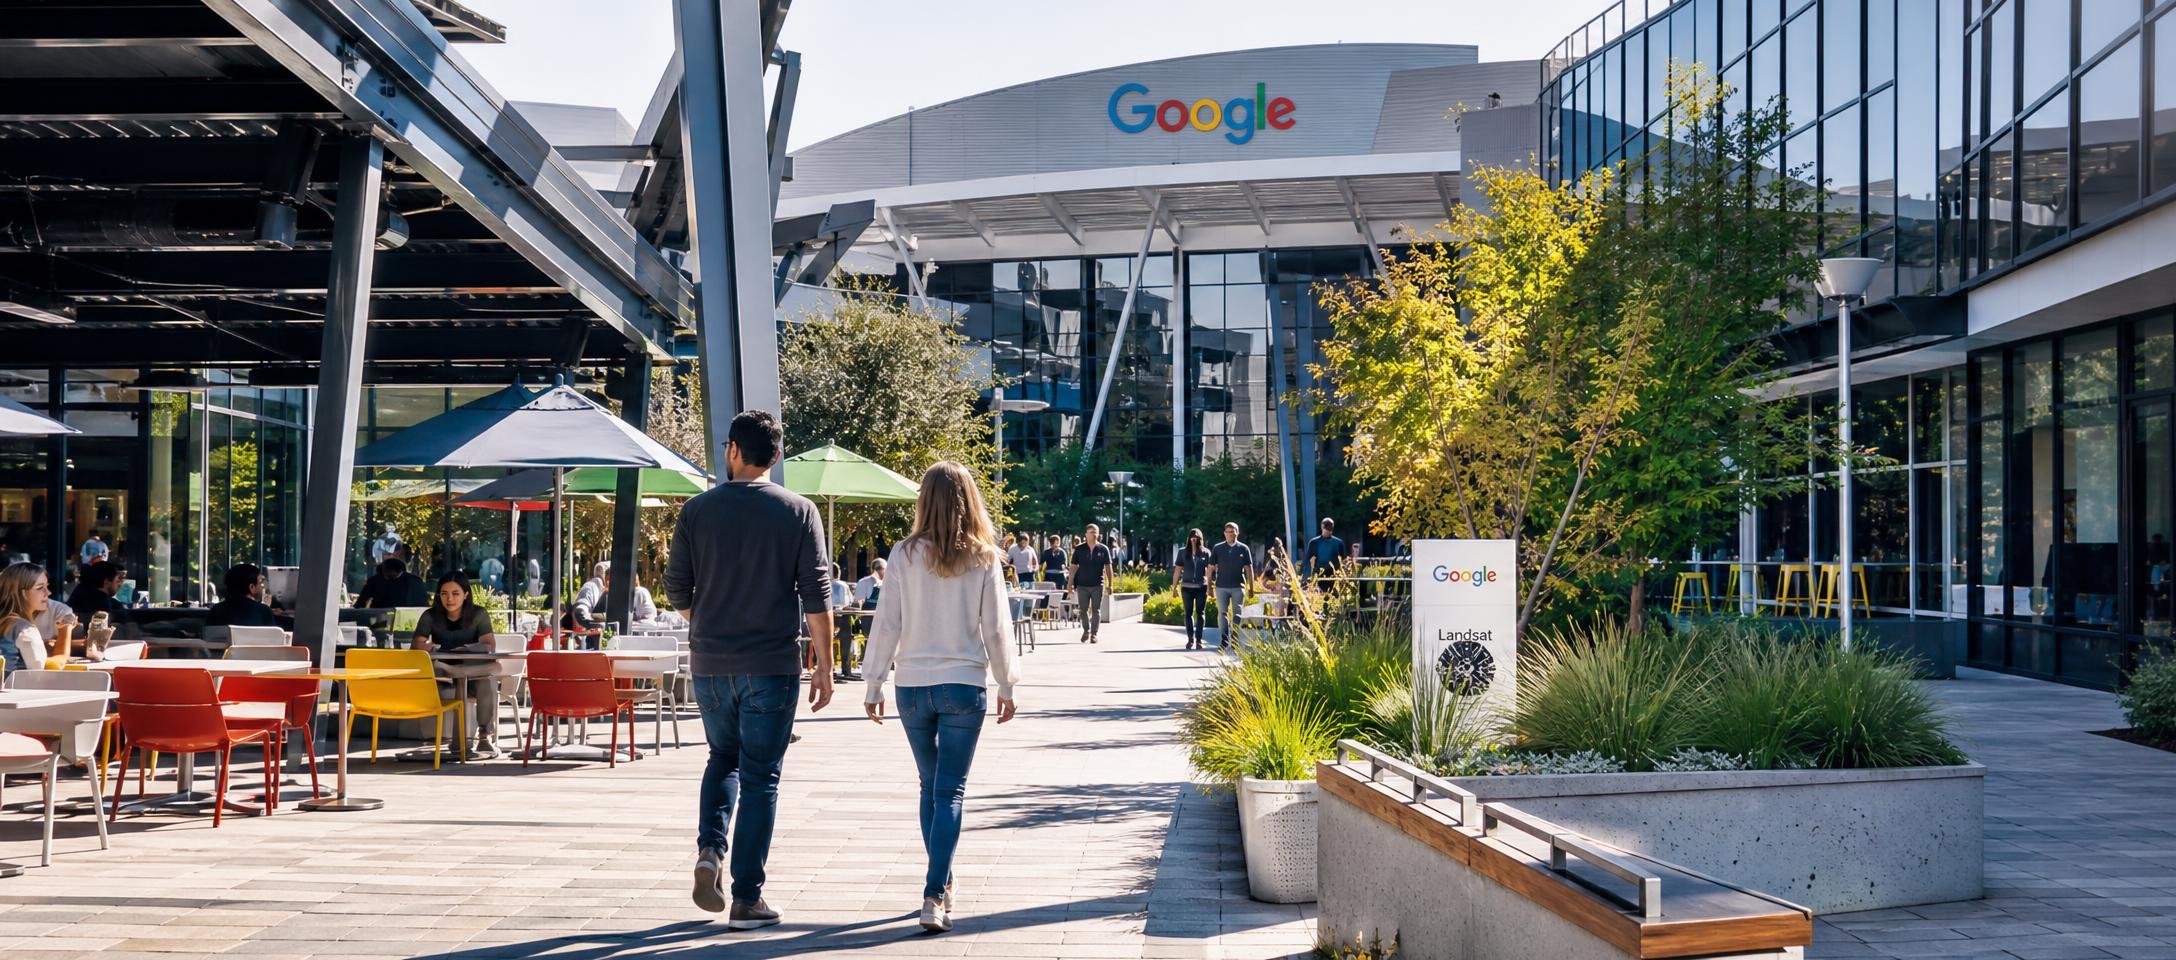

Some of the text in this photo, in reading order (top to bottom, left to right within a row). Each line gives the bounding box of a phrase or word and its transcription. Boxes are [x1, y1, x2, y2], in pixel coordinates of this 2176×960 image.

[1108, 82, 1297, 145] Google
[1433, 565, 1497, 587] Google
[1438, 629, 1493, 641] Landsat
